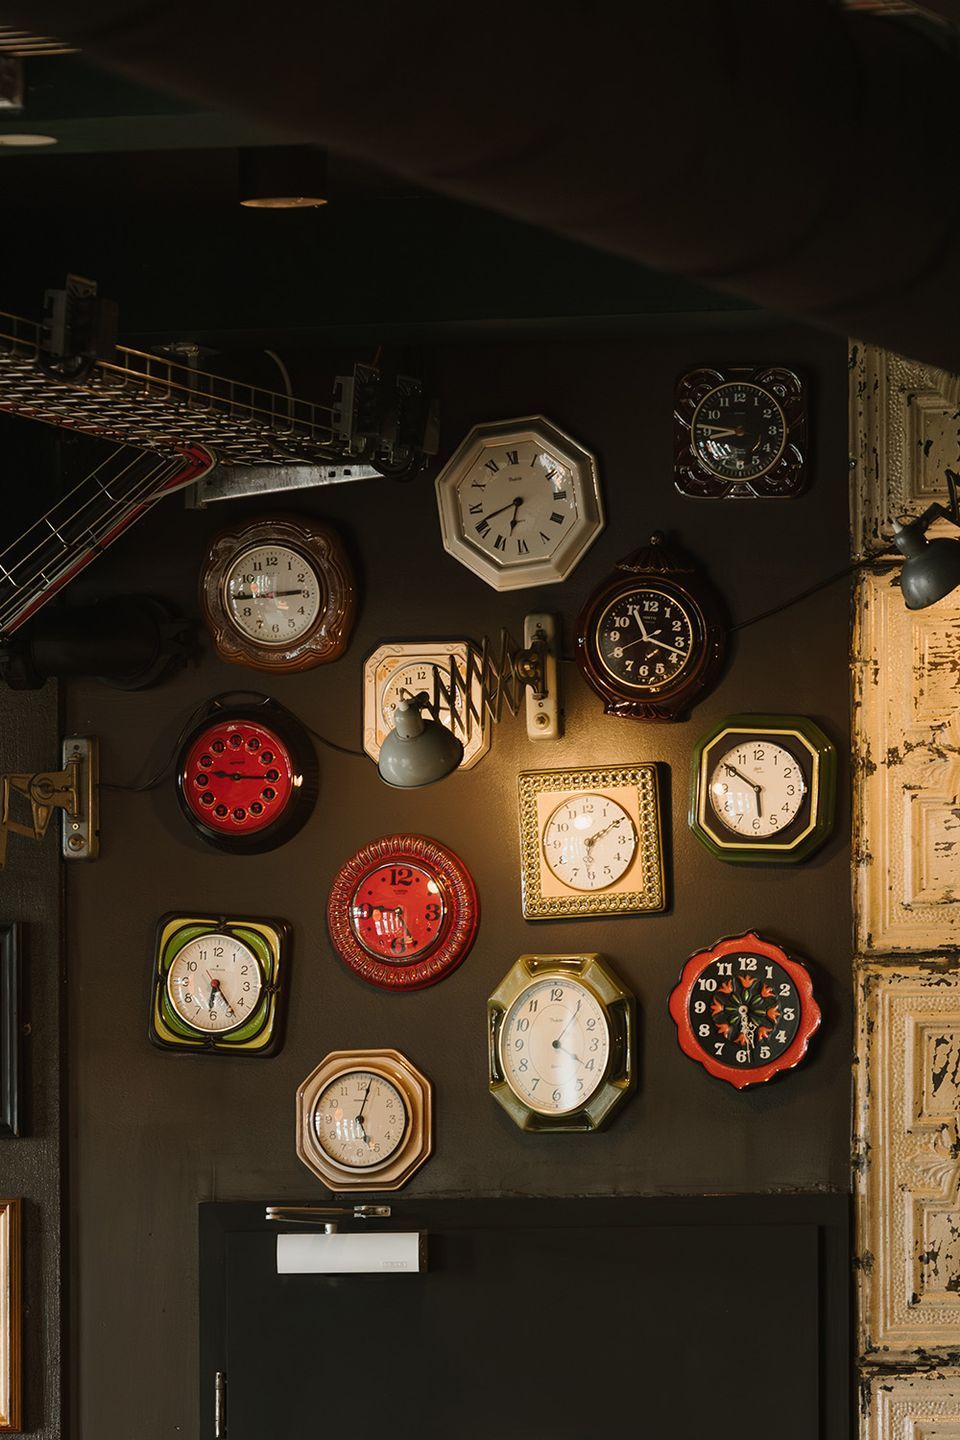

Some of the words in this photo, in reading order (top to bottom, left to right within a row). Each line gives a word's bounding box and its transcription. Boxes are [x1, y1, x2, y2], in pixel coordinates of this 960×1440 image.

[721, 398, 729, 407] 11
[734, 393, 746, 403] 12
[754, 397, 758, 406] 1
[708, 410, 720, 419] 10
[763, 409, 772, 418] 2
[703, 427, 712, 437] 9
[768, 426, 777, 435] 3
[763, 443, 771, 452] 4
[506, 451, 519, 465] XII
[752, 456, 760, 465] 5
[472, 480, 486, 492] X
[253, 562, 262, 571] 11
[266, 557, 278, 566] 12
[288, 562, 292, 570] 1
[242, 574, 255, 583] 10
[297, 574, 305, 582] 2
[302, 590, 310, 598] 3
[244, 607, 251, 616] 8
[297, 606, 304, 615] 4
[643, 601, 659, 612] 12
[664, 607, 671, 619] 1
[256, 620, 263, 629] 7
[288, 619, 295, 627] 5
[614, 616, 630, 628] 10
[672, 620, 681, 631] 2
[272, 624, 279, 633] 6
[610, 631, 620, 641] 9
[675, 636, 685, 647] 3
[613, 647, 624, 658] 8
[668, 653, 678, 663] 4
[625, 660, 634, 671] 7
[639, 665, 649, 676] 6
[655, 663, 665, 674] 5
[405, 677, 412, 685] 11
[417, 672, 426, 680] 12
[391, 703, 396, 711] 9
[738, 755, 746, 765] 11
[753, 750, 765, 761] 12
[774, 755, 777, 765] 1
[725, 766, 736, 777] 10
[784, 768, 792, 778] 2
[787, 785, 795, 795] 3
[582, 805, 594, 814] 12
[782, 802, 789, 813] 4
[569, 810, 577, 819] 11
[603, 809, 606, 817] 1
[736, 814, 744, 824] 7
[770, 815, 778, 825] 5
[557, 824, 569, 832] 10
[752, 819, 760, 830] 6
[553, 840, 561, 848] 9
[618, 836, 626, 845] 3
[613, 852, 621, 861] 4
[573, 868, 579, 876] 7
[604, 866, 611, 874] 5
[390, 869, 413, 886] 12
[425, 904, 440, 921] 3
[391, 938, 406, 954] 6
[200, 951, 207, 960] 11
[213, 948, 224, 957] 12
[233, 954, 236, 963] 1
[187, 961, 197, 972] 10
[717, 963, 733, 976] 11
[738, 958, 758, 971] 12
[241, 966, 249, 975] 2
[765, 966, 773, 979] 1
[243, 982, 250, 992] 3
[698, 979, 717, 992] 10
[780, 984, 791, 997] 2
[185, 993, 192, 1003] 8
[550, 989, 564, 1002] 12
[237, 997, 244, 1007] 4
[529, 1000, 538, 1012] 11
[576, 1000, 581, 1012] 1
[195, 1006, 201, 1015] 7
[694, 1001, 706, 1014] 9
[210, 1011, 217, 1021] 6
[783, 1008, 795, 1021] 3
[516, 1018, 530, 1032] 10
[586, 1018, 596, 1031] 2
[699, 1024, 710, 1037] 8
[775, 1030, 787, 1043] 4
[515, 1039, 524, 1052] 9
[589, 1038, 600, 1051] 3
[714, 1043, 725, 1055] 7
[736, 1050, 747, 1063] 6
[760, 1046, 771, 1059] 5
[518, 1058, 528, 1072] 8
[585, 1059, 595, 1072] 4
[357, 1082, 367, 1091] 12
[532, 1078, 540, 1091] 7
[576, 1079, 584, 1091] 5
[340, 1087, 348, 1096] 11
[377, 1087, 380, 1096] 1
[552, 1089, 562, 1102] 6
[329, 1099, 339, 1108] 10
[386, 1099, 393, 1108] 2
[326, 1115, 332, 1124] 9
[389, 1115, 396, 1124] 3
[329, 1131, 336, 1140] 8
[384, 1131, 391, 1140] 4
[357, 1149, 364, 1157] 6
